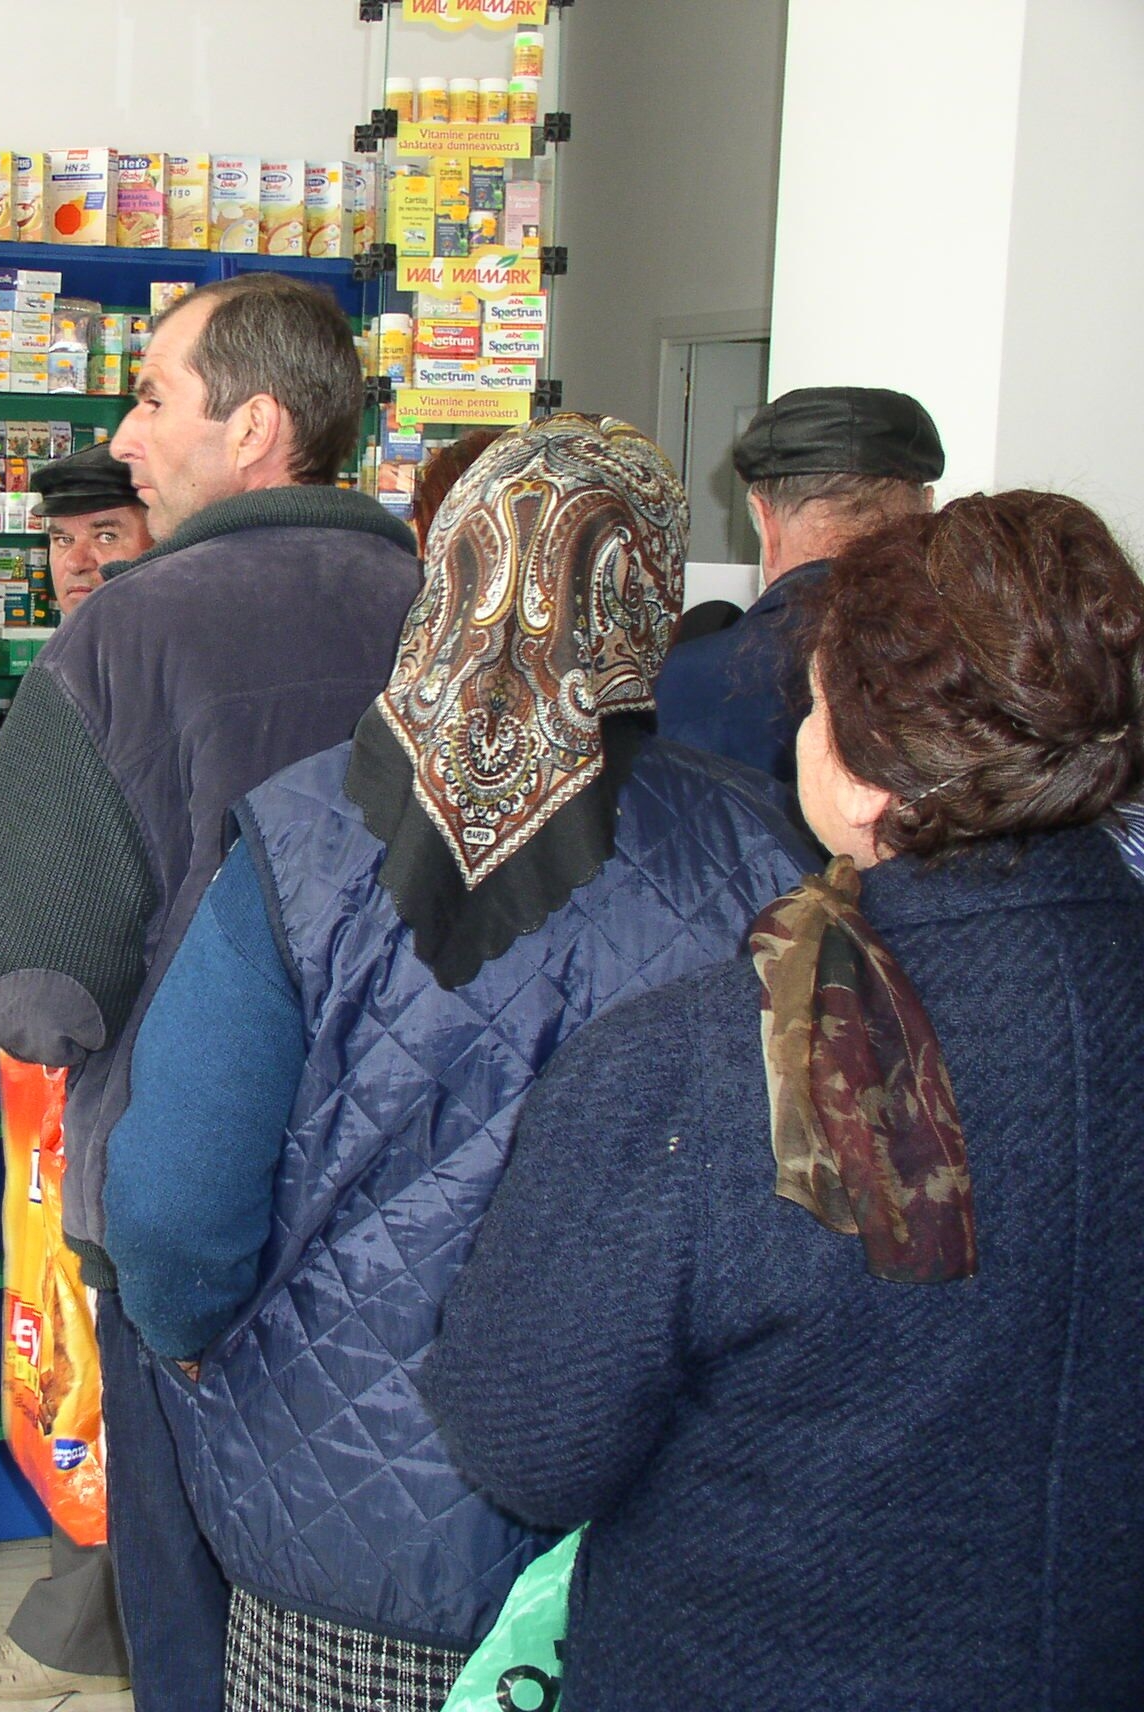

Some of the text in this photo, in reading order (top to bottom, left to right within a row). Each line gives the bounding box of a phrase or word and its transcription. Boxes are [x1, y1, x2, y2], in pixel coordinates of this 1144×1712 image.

[413, 0, 447, 13] WAL
[456, 0, 536, 15] WALMARK
[420, 128, 500, 141] Vitamine pentru
[398, 141, 520, 151] sănătatea dumneavoastră
[64, 163, 78, 173] HN
[119, 158, 148, 169] Hero
[120, 171, 141, 181] Baby
[168, 190, 191, 198] rigo
[407, 268, 444, 282] WAL
[452, 268, 531, 284] WALMARK
[423, 303, 461, 313] Spectr
[491, 306, 542, 319] Spectrum
[489, 341, 540, 351] Spectrum
[420, 370, 474, 381] Spectrum
[481, 375, 531, 386] Spectrum
[420, 396, 499, 408] Vitamine pentru
[399, 408, 519, 418] sănătatea dumneavoastră
